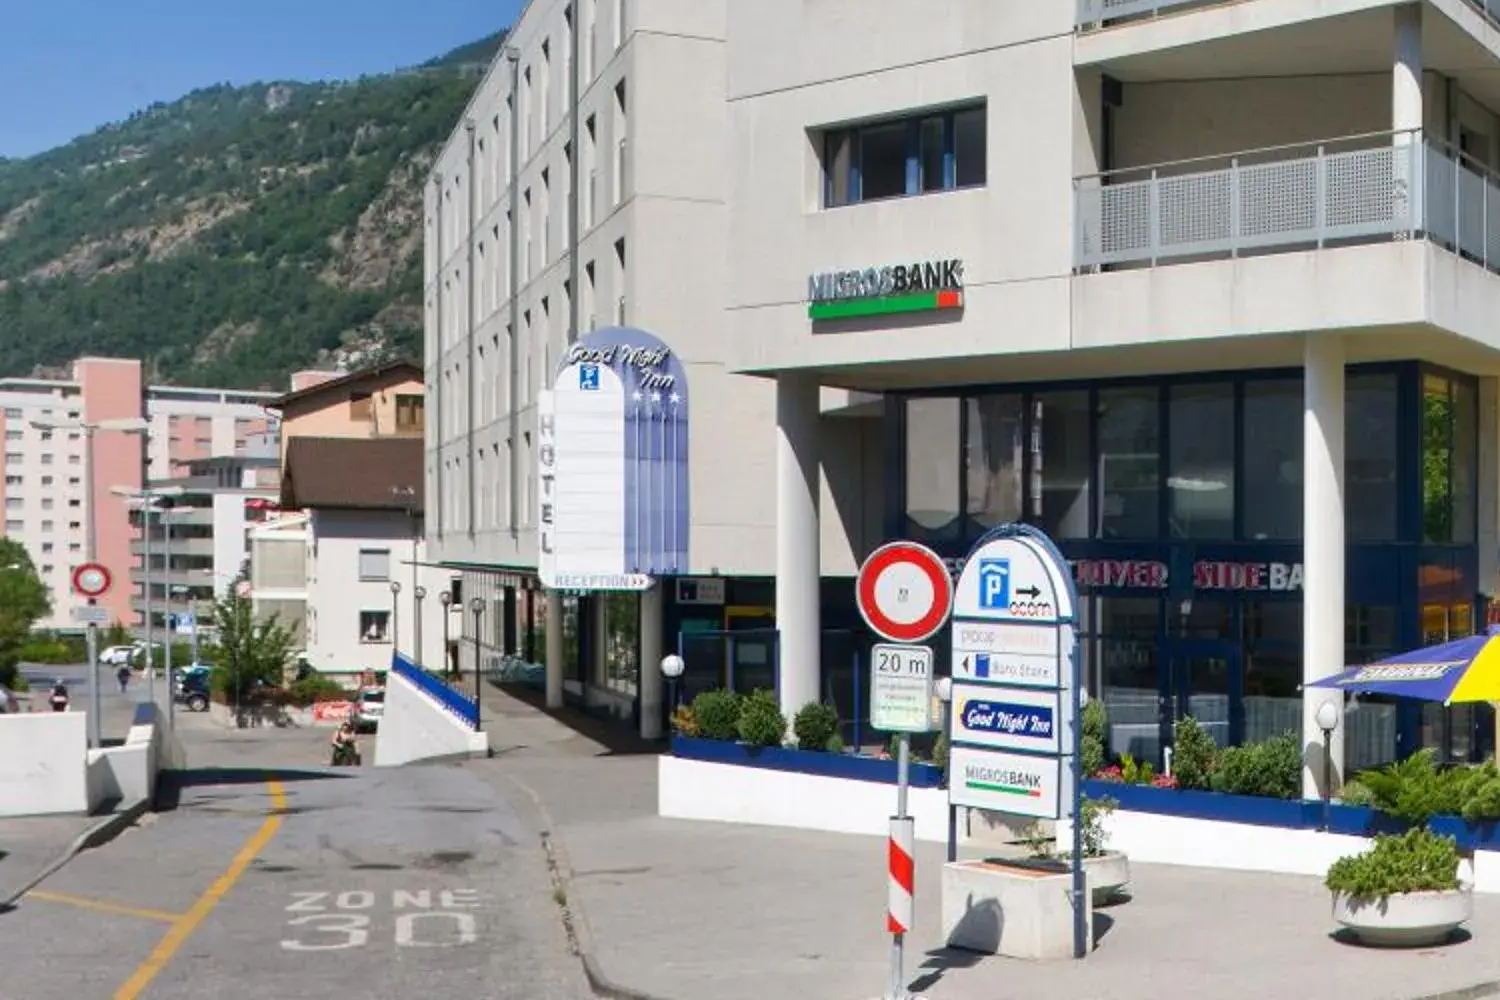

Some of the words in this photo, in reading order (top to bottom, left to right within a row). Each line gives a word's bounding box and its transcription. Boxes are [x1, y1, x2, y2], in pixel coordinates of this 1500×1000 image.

[568, 342, 619, 366] Good
[620, 344, 671, 367] Night
[640, 367, 676, 390] Inn
[540, 414, 555, 554] HOTEL
[555, 573, 629, 587] RECEPTION
[879, 653, 901, 673] 20
[909, 659, 926, 675] m
[967, 709, 995, 728] Good
[997, 711, 1029, 733] Night
[1030, 715, 1051, 733] Inn
[964, 765, 1041, 788] MIGROSBANK
[284, 888, 481, 912] ZONE
[279, 911, 479, 951] 30
